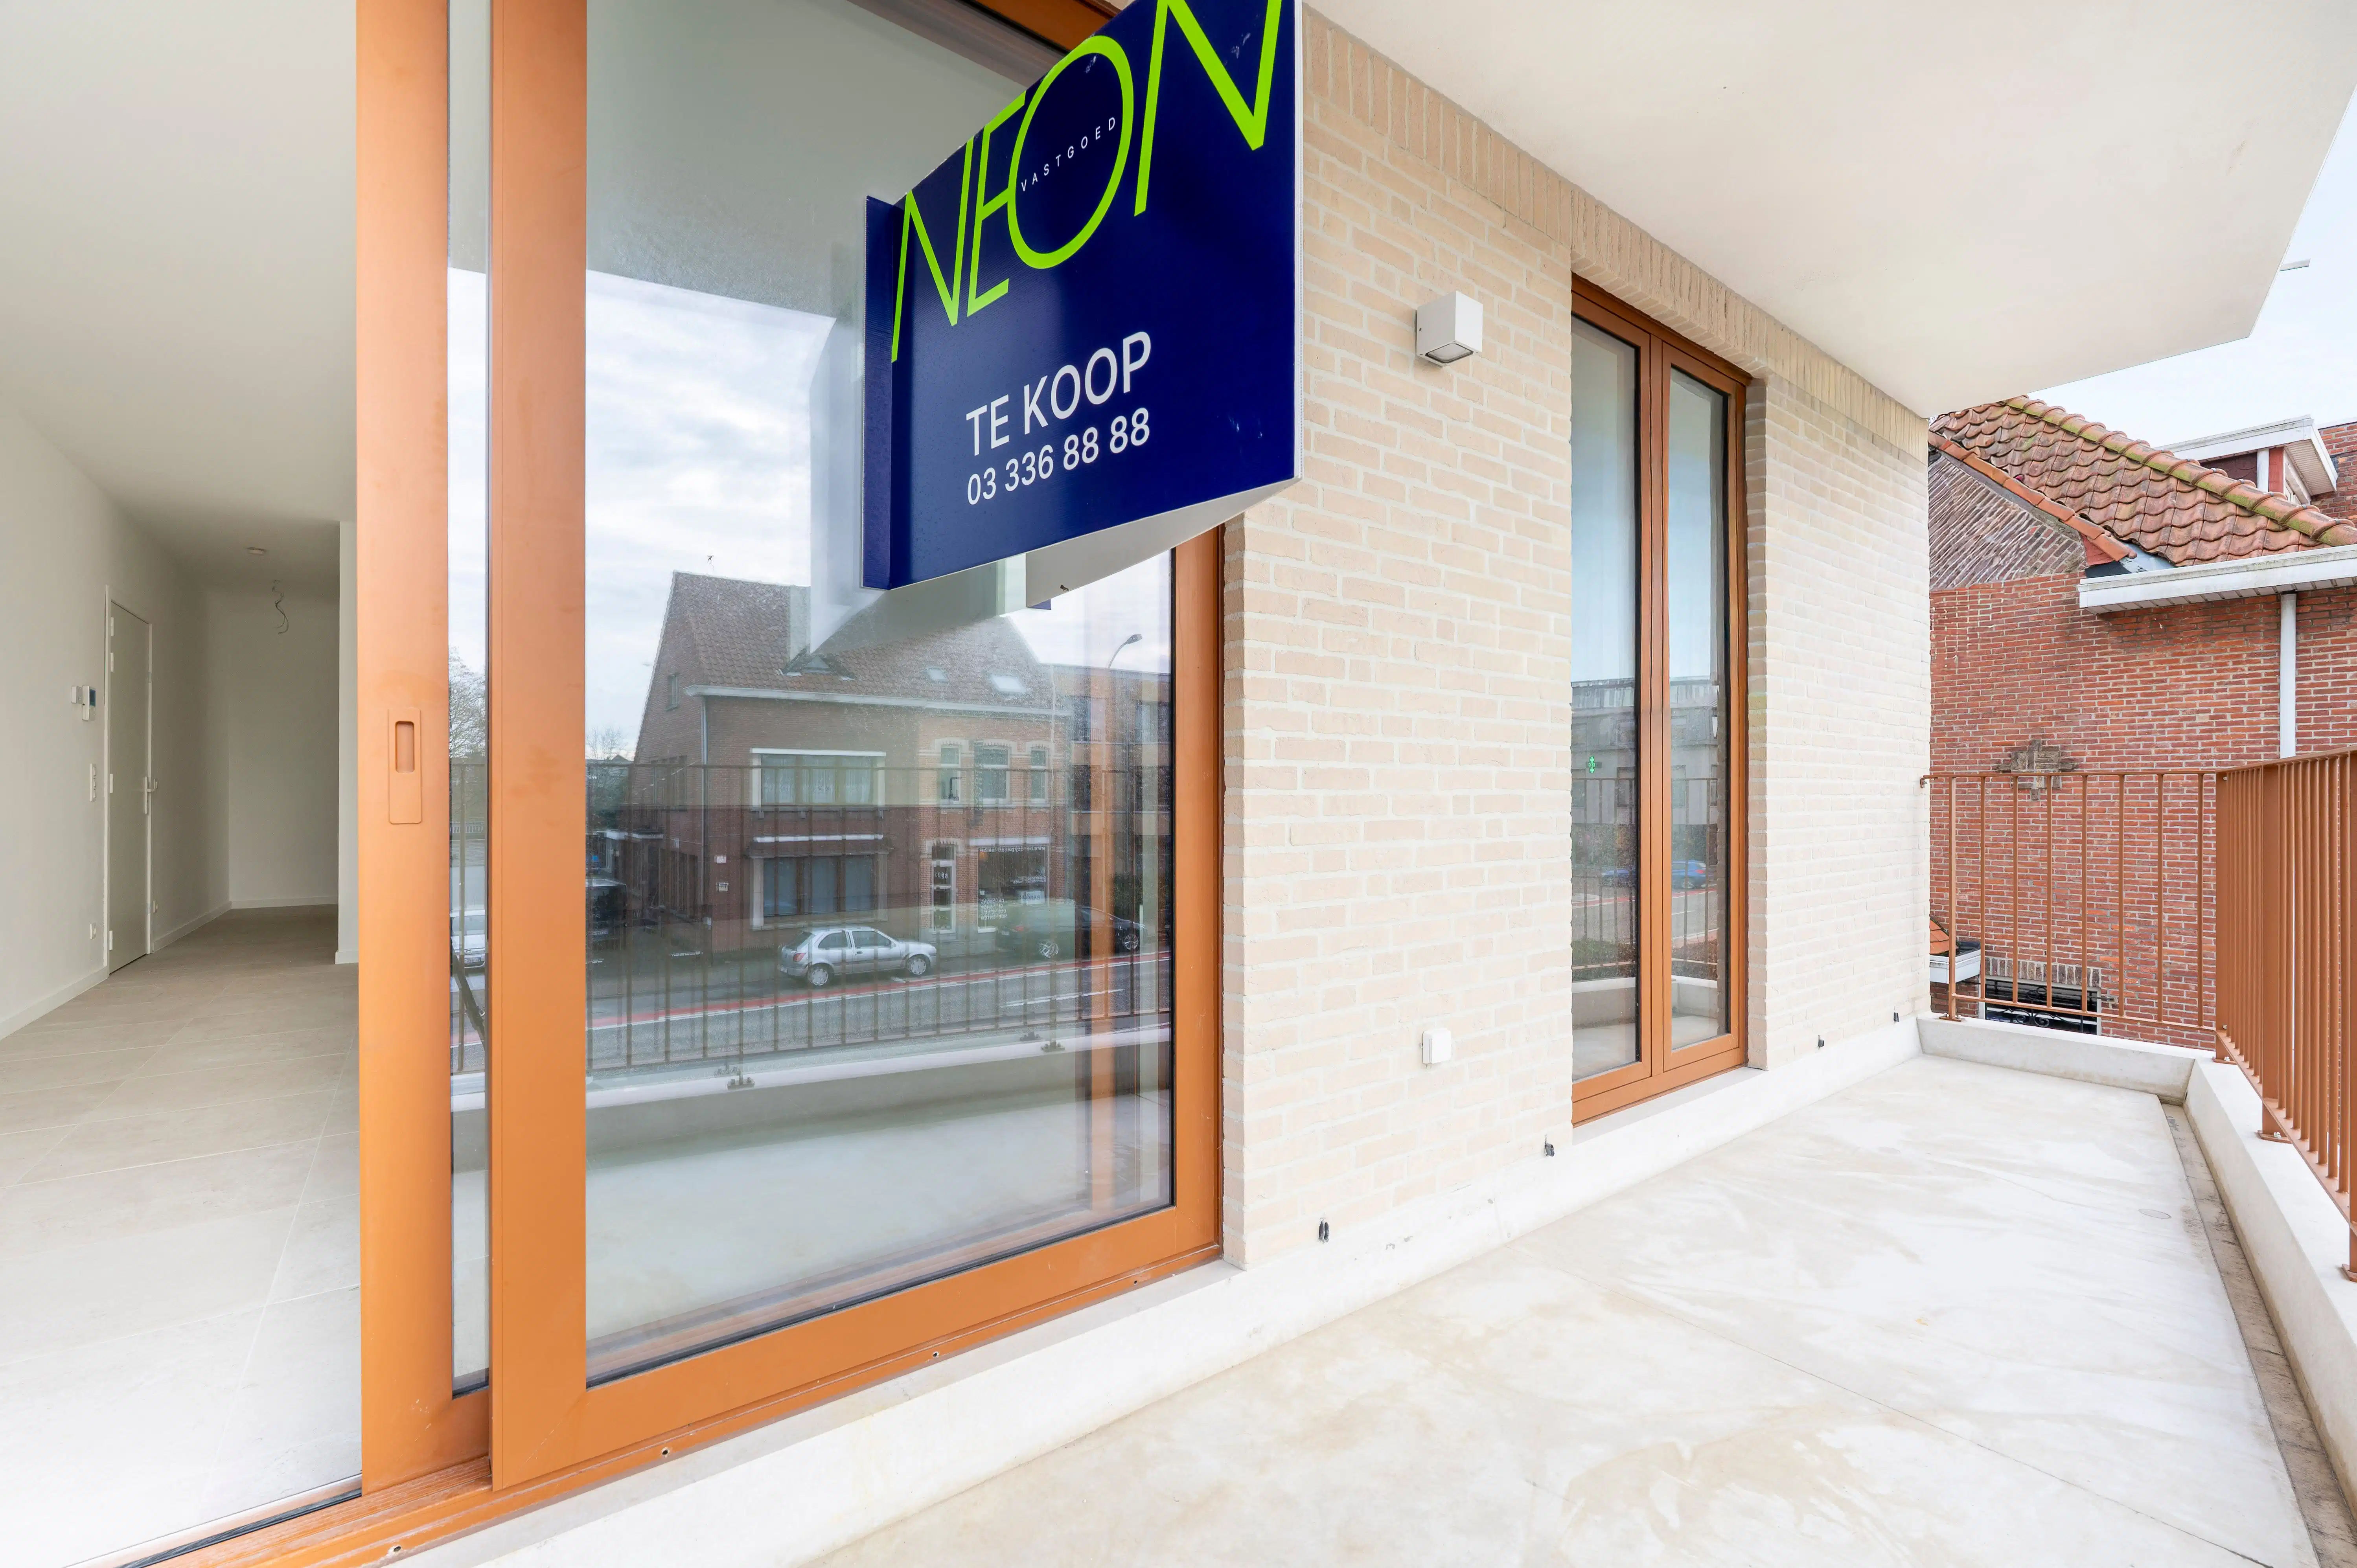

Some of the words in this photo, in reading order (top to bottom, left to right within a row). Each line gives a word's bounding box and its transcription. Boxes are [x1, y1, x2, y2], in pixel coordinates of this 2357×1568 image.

[891, 0, 1282, 363] NEON
[1021, 117, 1116, 192] VASTGOED
[966, 394, 1010, 456] TE
[1023, 331, 1152, 435] KOOP
[967, 467, 997, 506] 03
[1005, 444, 1054, 492] 336
[1063, 426, 1099, 471] 88
[1109, 407, 1150, 454] 88
